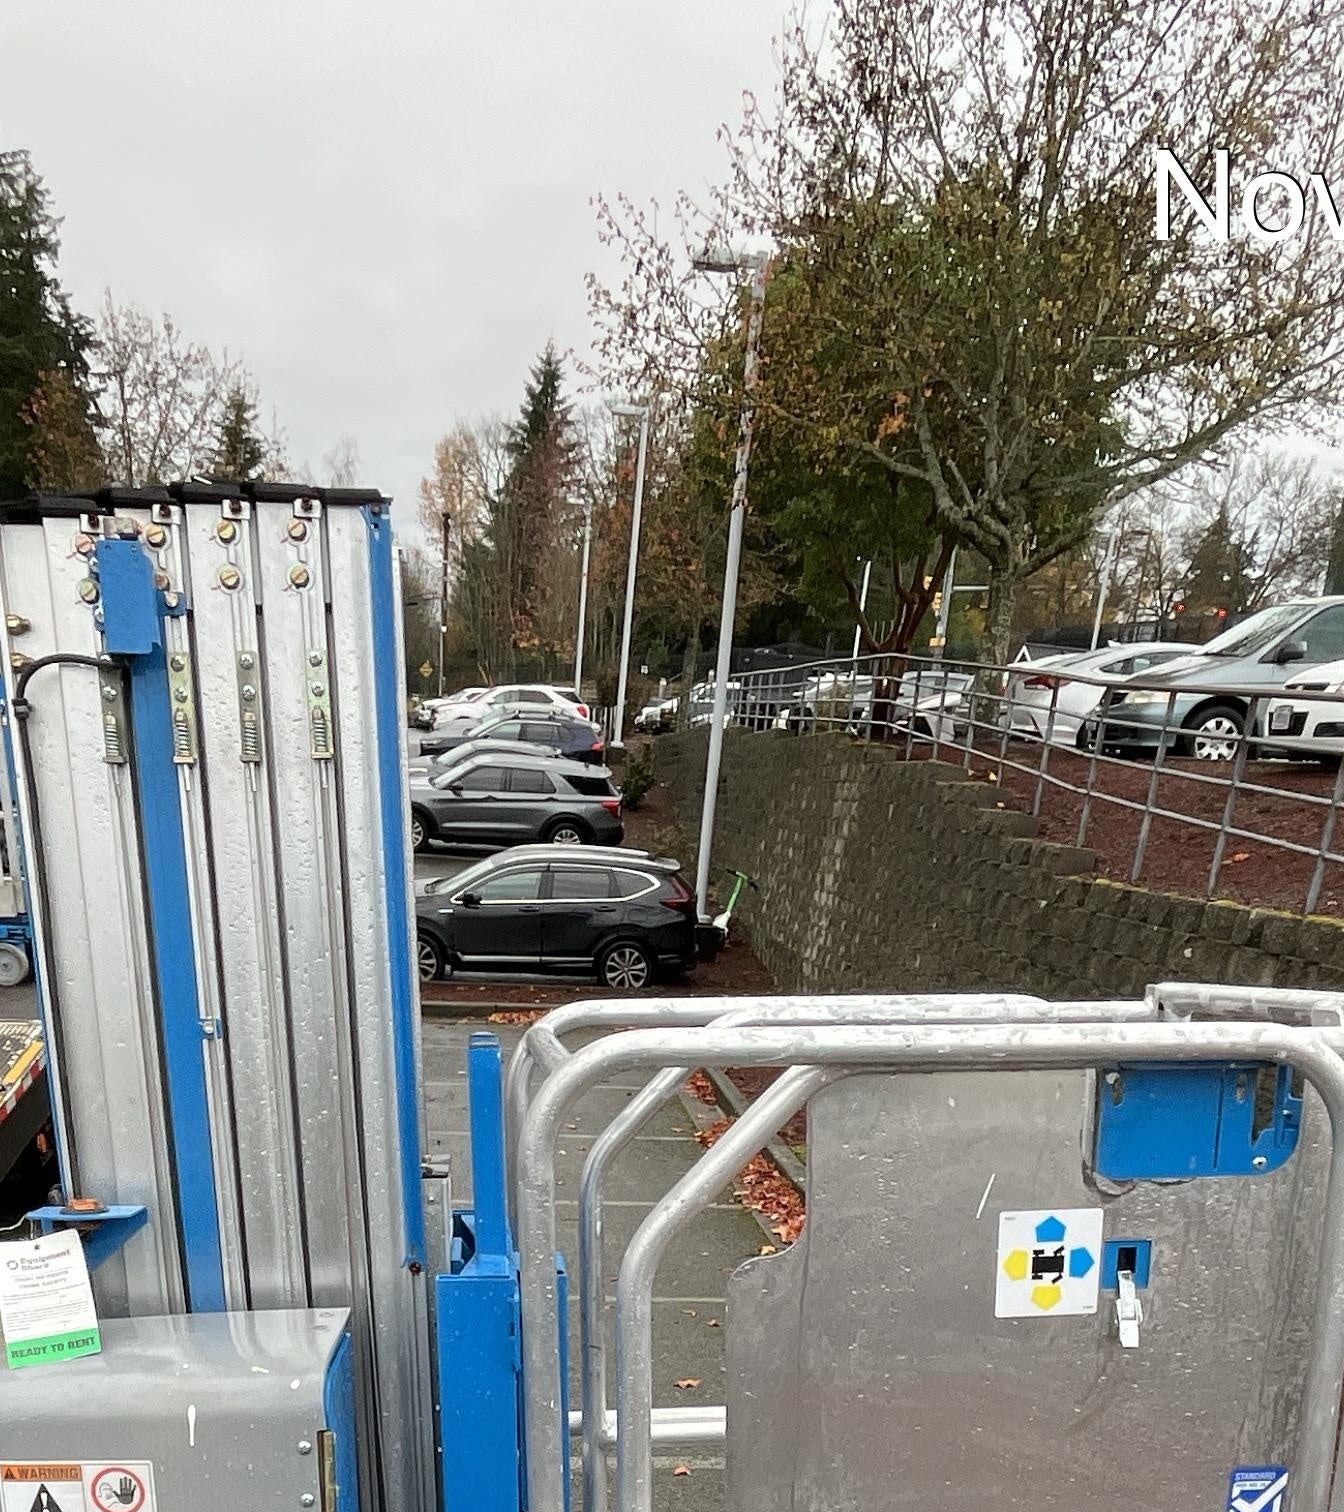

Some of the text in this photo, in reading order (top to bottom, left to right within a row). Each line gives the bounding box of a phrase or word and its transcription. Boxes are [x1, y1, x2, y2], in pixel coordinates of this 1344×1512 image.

[10, 1336, 96, 1359] READY TO RENT
[17, 1466, 80, 1481] WARNING
